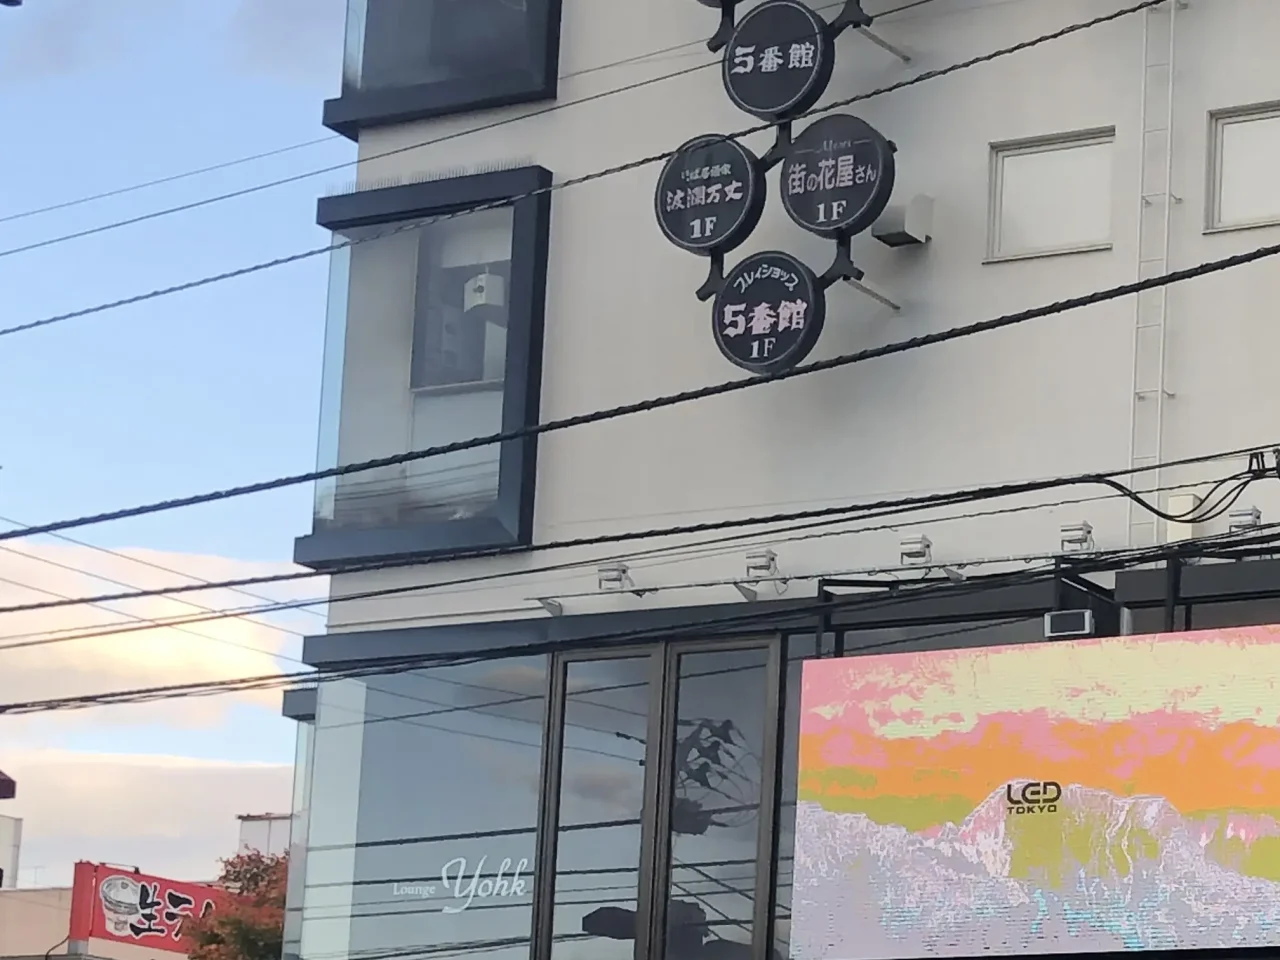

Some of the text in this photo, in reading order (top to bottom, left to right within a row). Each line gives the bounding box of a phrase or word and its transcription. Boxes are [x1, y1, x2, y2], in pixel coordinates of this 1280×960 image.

[731, 41, 816, 75] 5番館
[787, 154, 878, 197] 街の花屋さん
[816, 200, 847, 223] 1F
[689, 216, 718, 239] 1F
[722, 299, 808, 339] 5番館
[750, 337, 776, 359] 1F
[1006, 781, 1062, 805] LED
[1007, 804, 1058, 815] TOKYO
[393, 882, 437, 897] Lounge
